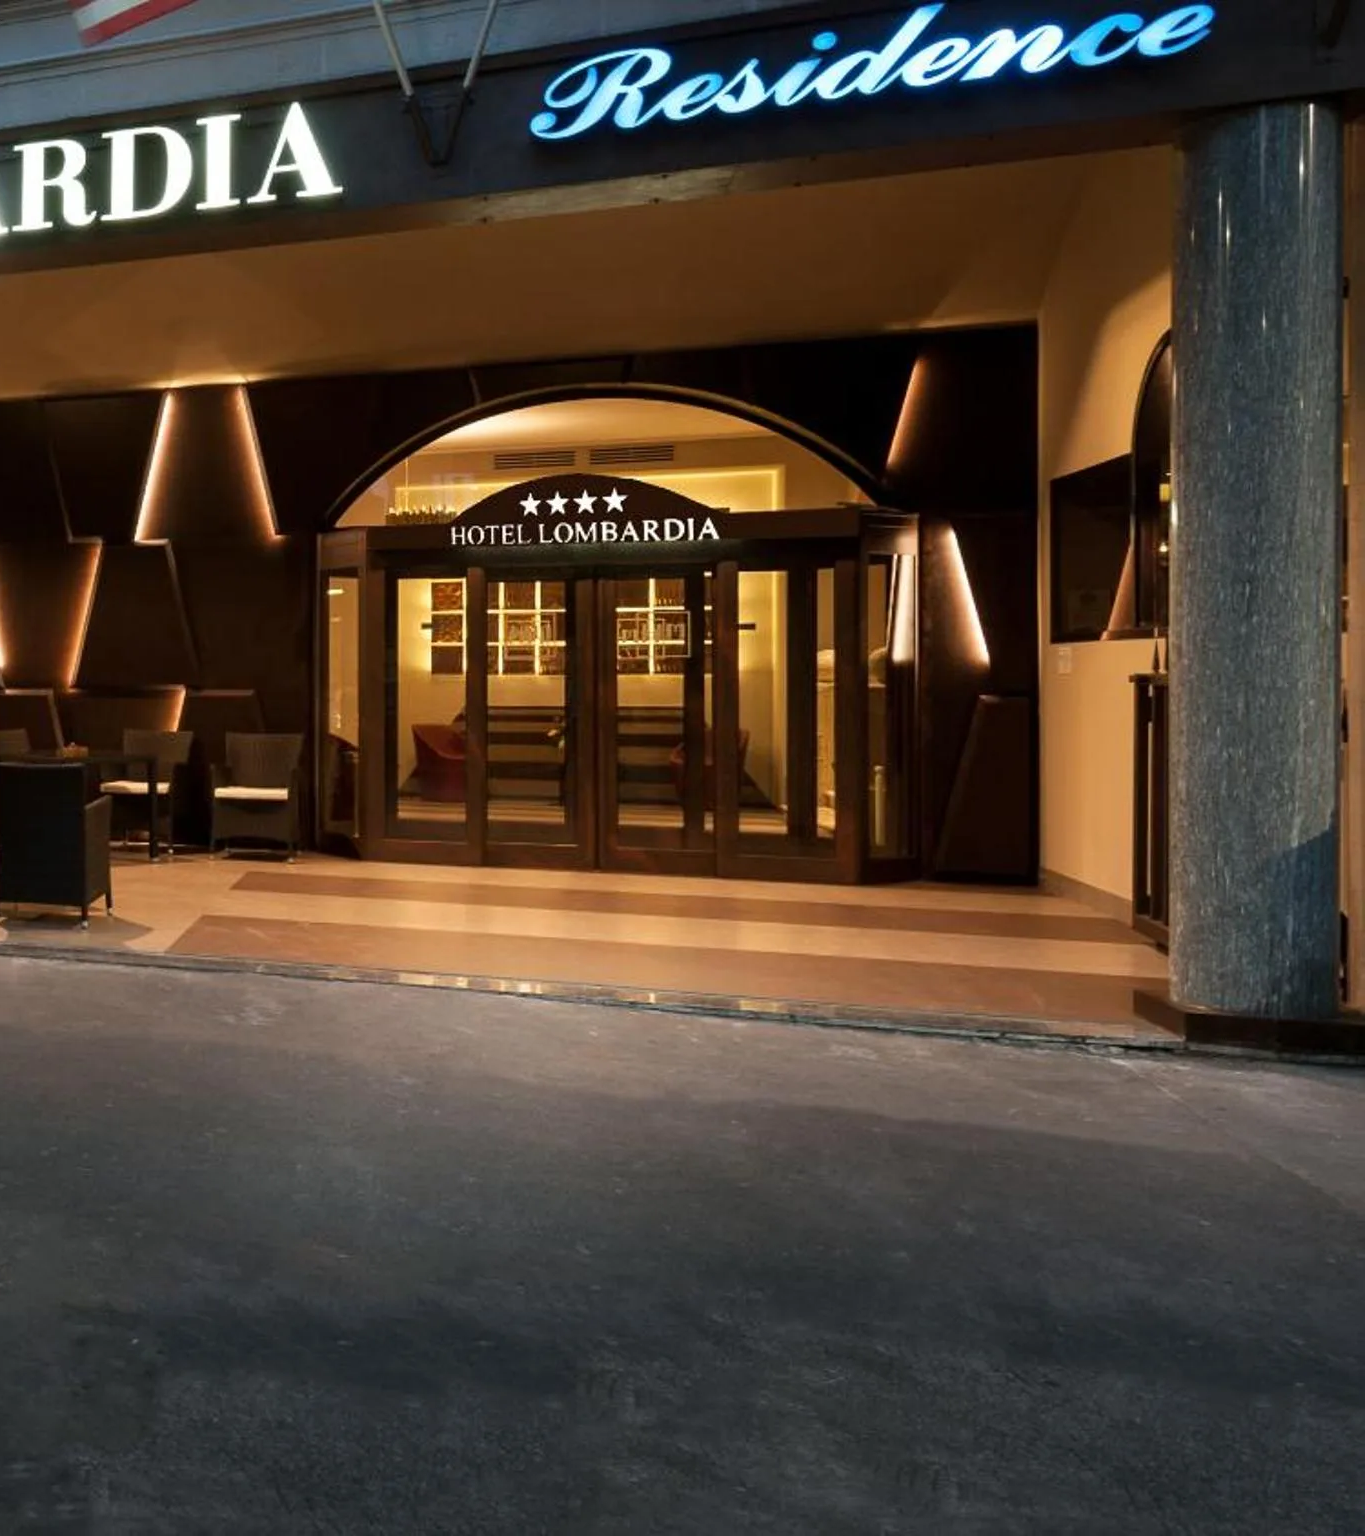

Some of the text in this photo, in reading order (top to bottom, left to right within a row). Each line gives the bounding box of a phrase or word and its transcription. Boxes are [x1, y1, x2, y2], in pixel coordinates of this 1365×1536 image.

[529, 2, 1216, 140] Residence
[450, 516, 720, 545] HOTEL LOMBARDIA
